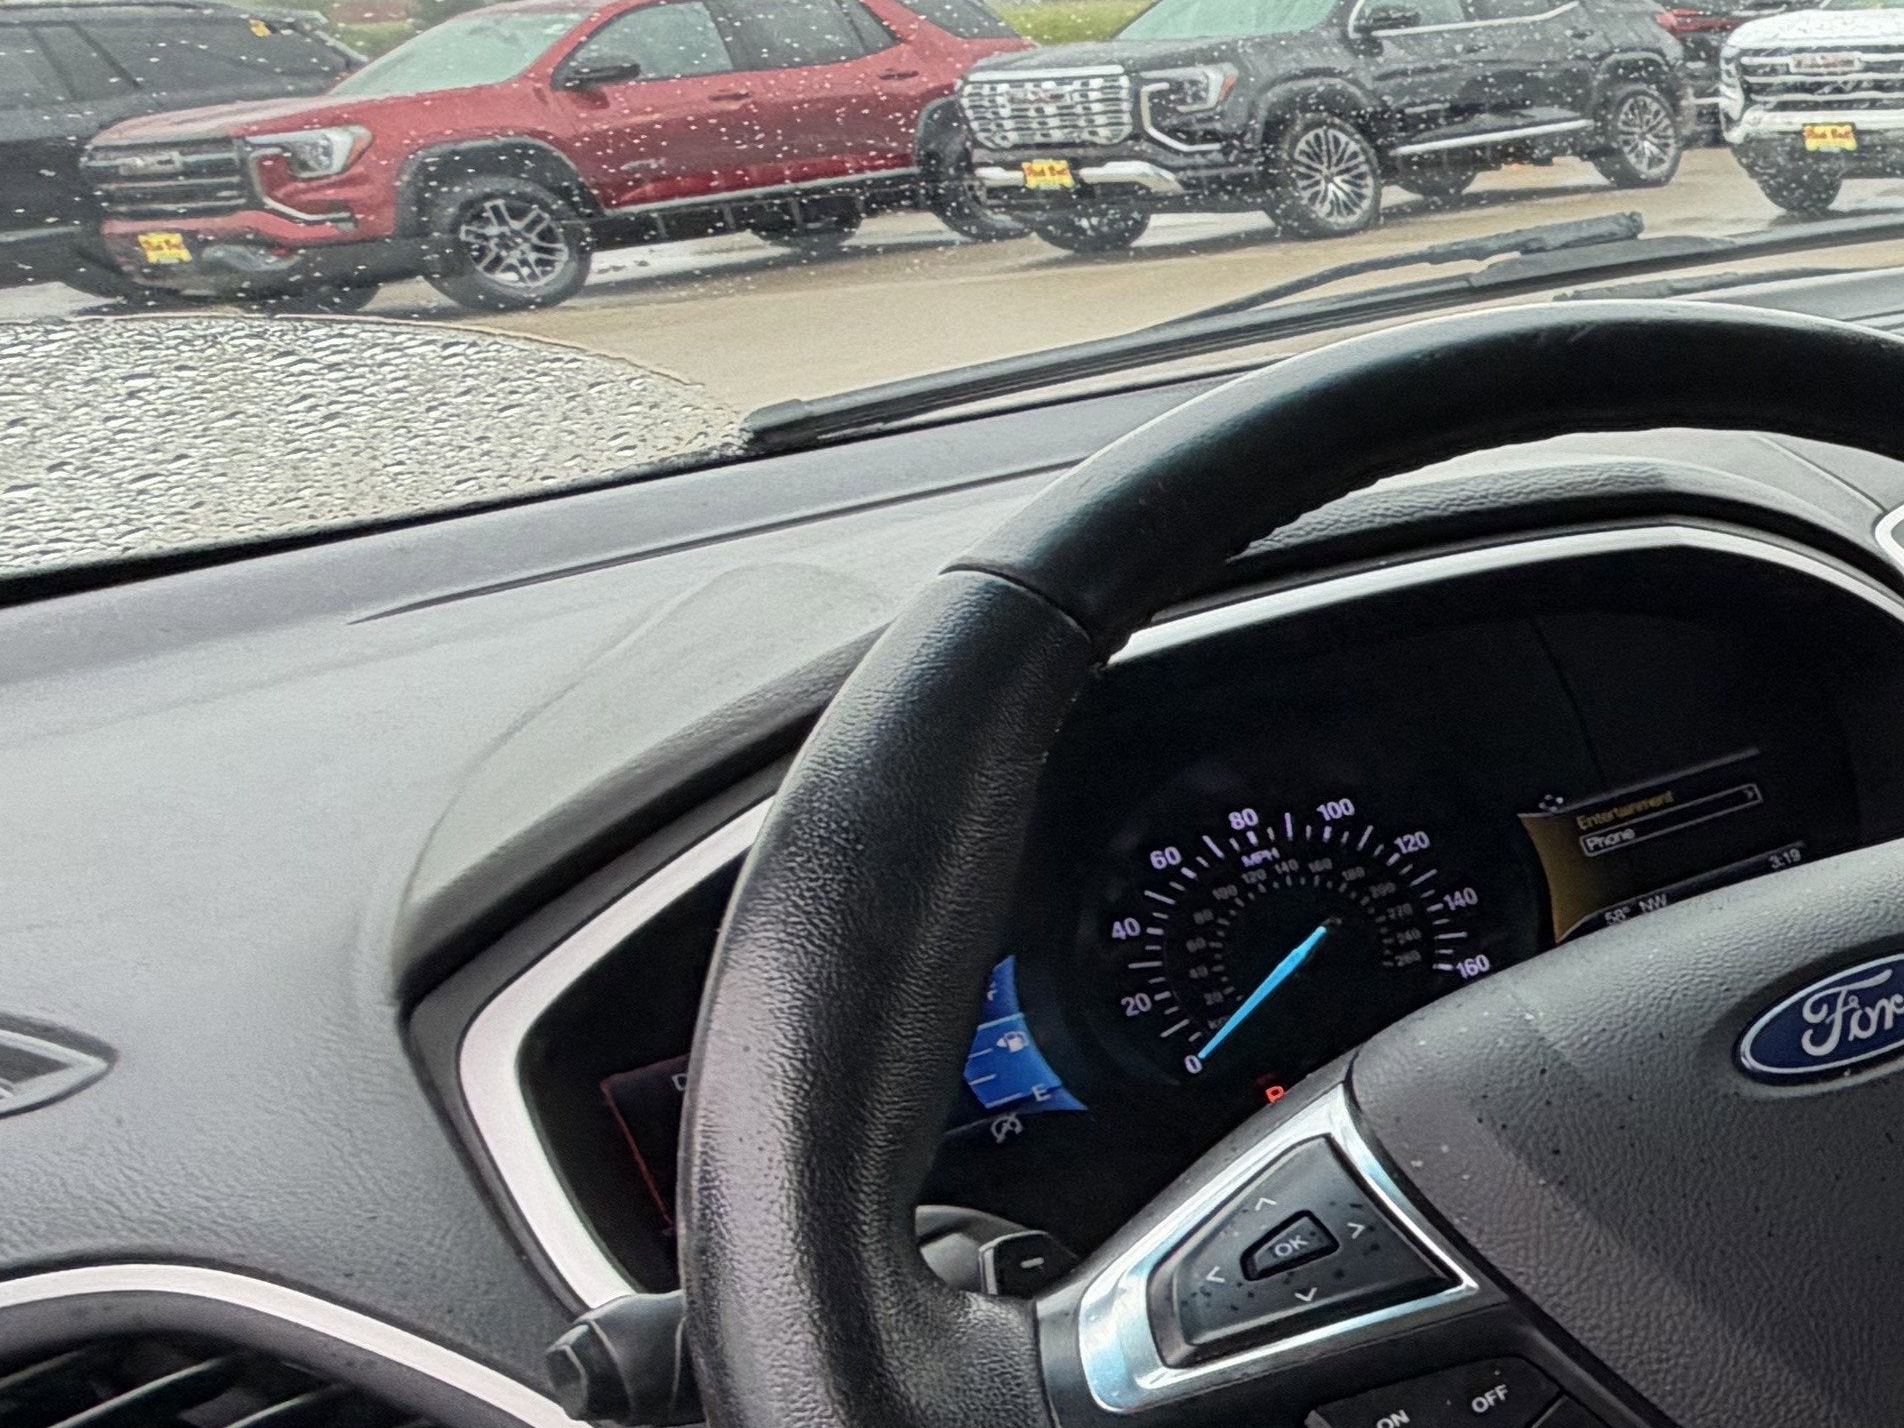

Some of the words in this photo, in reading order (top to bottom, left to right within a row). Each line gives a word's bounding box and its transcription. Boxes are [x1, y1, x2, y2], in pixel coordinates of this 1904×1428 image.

[1228, 807, 1259, 831] 80
[1316, 798, 1356, 822] 100
[1576, 790, 1675, 830] Entertainment
[1394, 830, 1431, 855] 120
[1585, 827, 1636, 852] Phone
[1149, 846, 1182, 870] 60
[1767, 847, 1801, 869] 3:19
[1443, 887, 1479, 912] 140
[1639, 893, 1669, 914] NW
[1111, 917, 1142, 940] 40
[1455, 953, 1491, 980] 160
[1120, 992, 1152, 1017] 20
[1183, 1054, 1204, 1074] 0
[1030, 1084, 1051, 1102] E
[1264, 1085, 1286, 1104] P
[1274, 1234, 1309, 1258] OK
[1471, 1384, 1509, 1415] OFF
